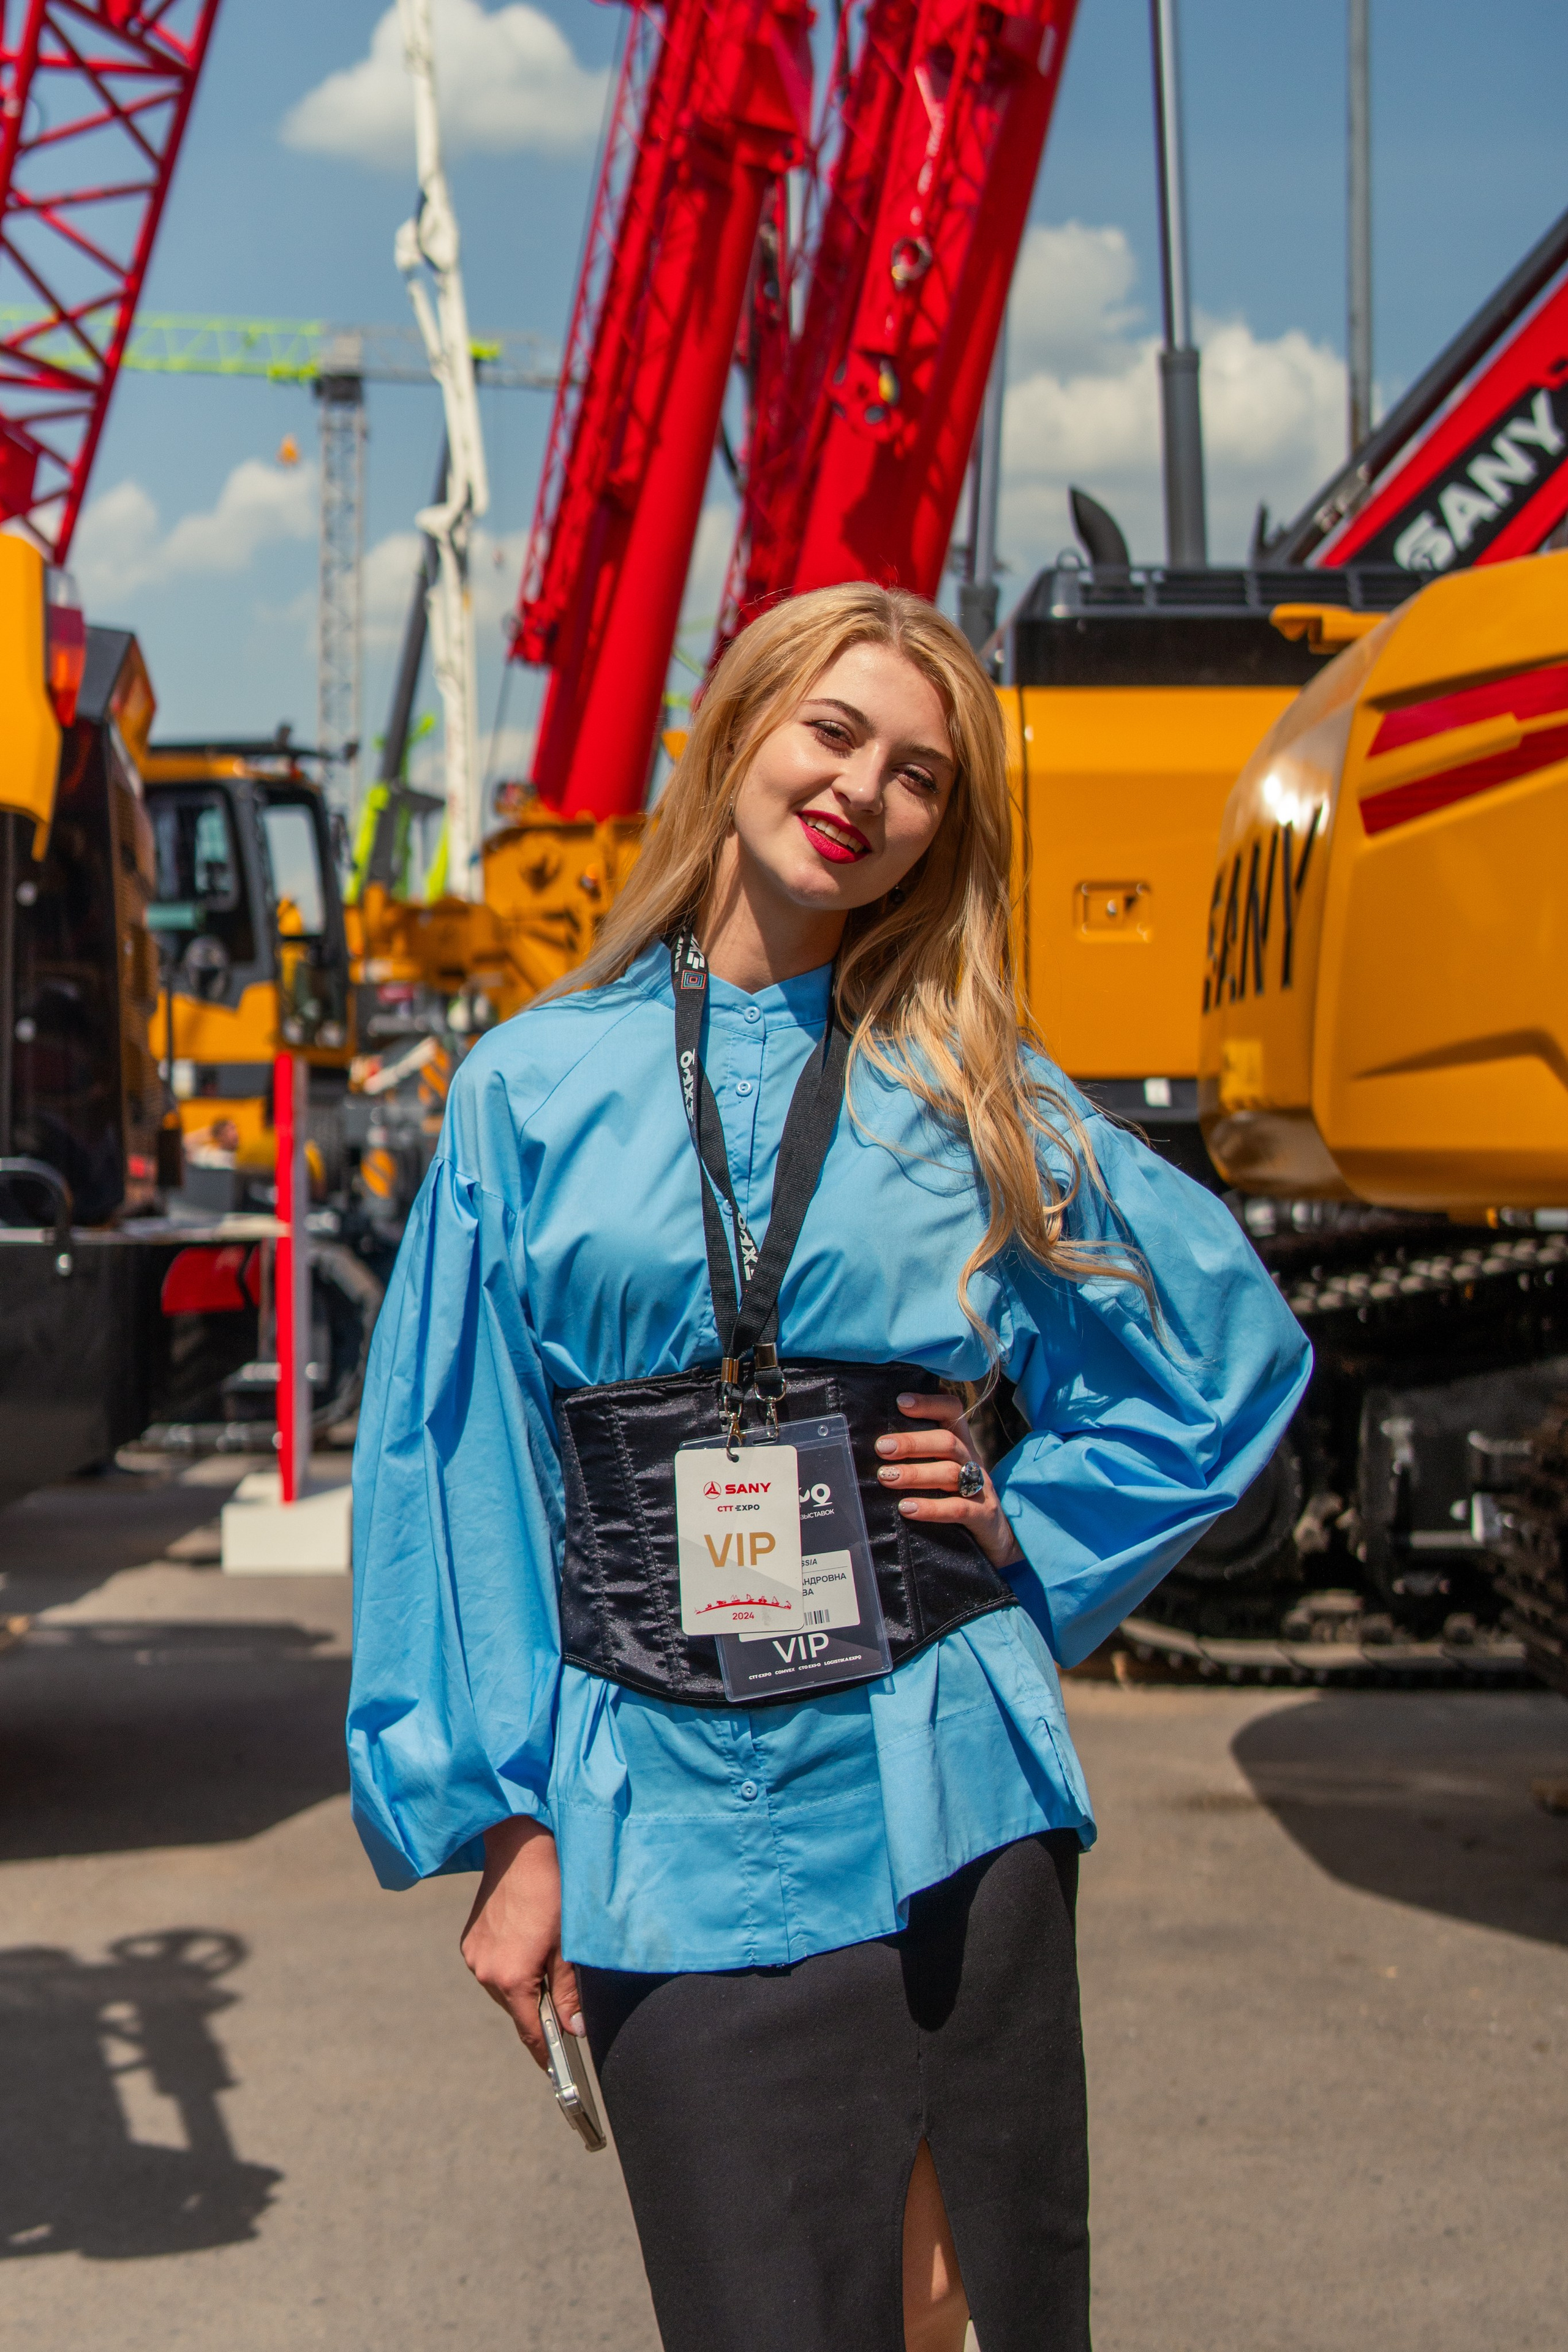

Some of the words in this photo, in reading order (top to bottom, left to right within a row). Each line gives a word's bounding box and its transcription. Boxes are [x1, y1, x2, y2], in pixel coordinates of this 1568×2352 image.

[1394, 388, 1566, 571] SANY
[680, 1048, 695, 1121] EXPO
[725, 1482, 771, 1494] SANY
[704, 1532, 775, 1567] VIP
[772, 1632, 829, 1663] VIP
